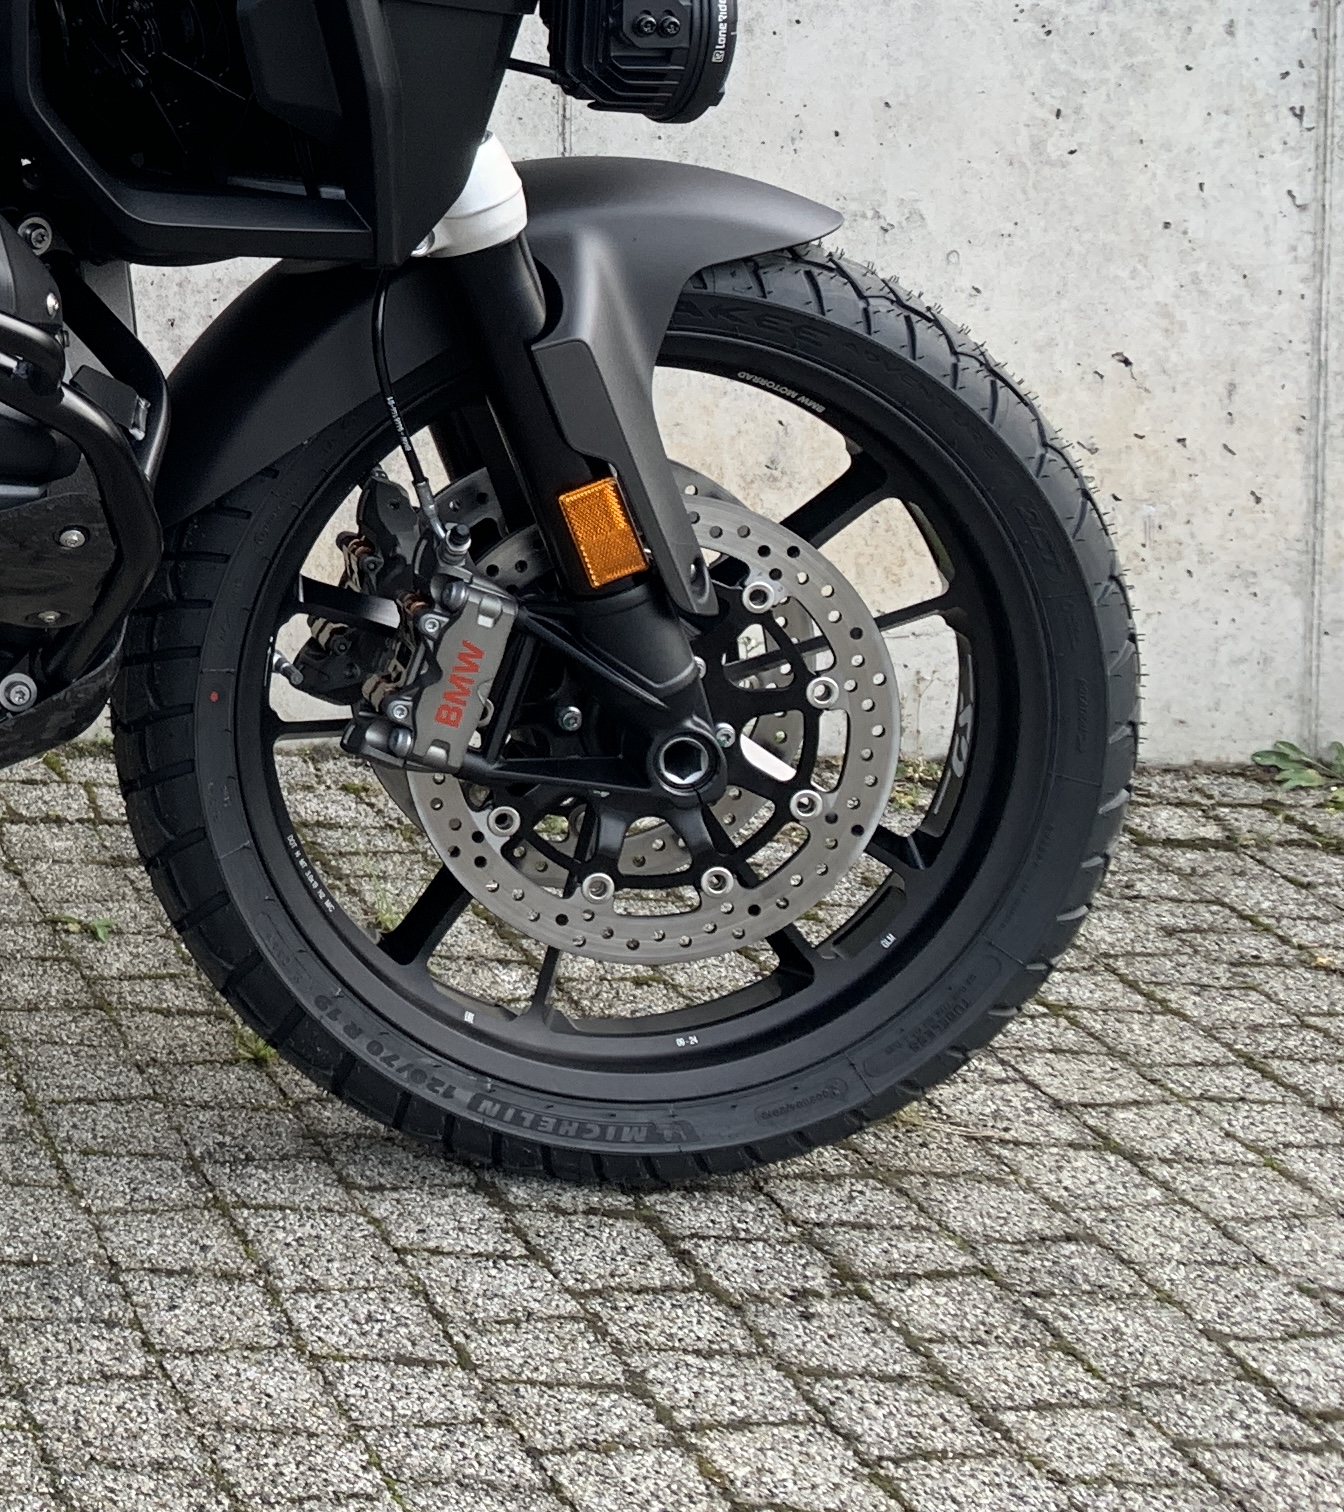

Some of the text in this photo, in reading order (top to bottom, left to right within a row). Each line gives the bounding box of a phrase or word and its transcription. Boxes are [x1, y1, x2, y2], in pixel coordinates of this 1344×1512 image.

[737, 371, 826, 413] BMW MOTORRAD
[434, 639, 486, 730] BMW
[288, 835, 297, 848] DOT
[310, 990, 649, 1143] MICHELIN 120/70 R 19
